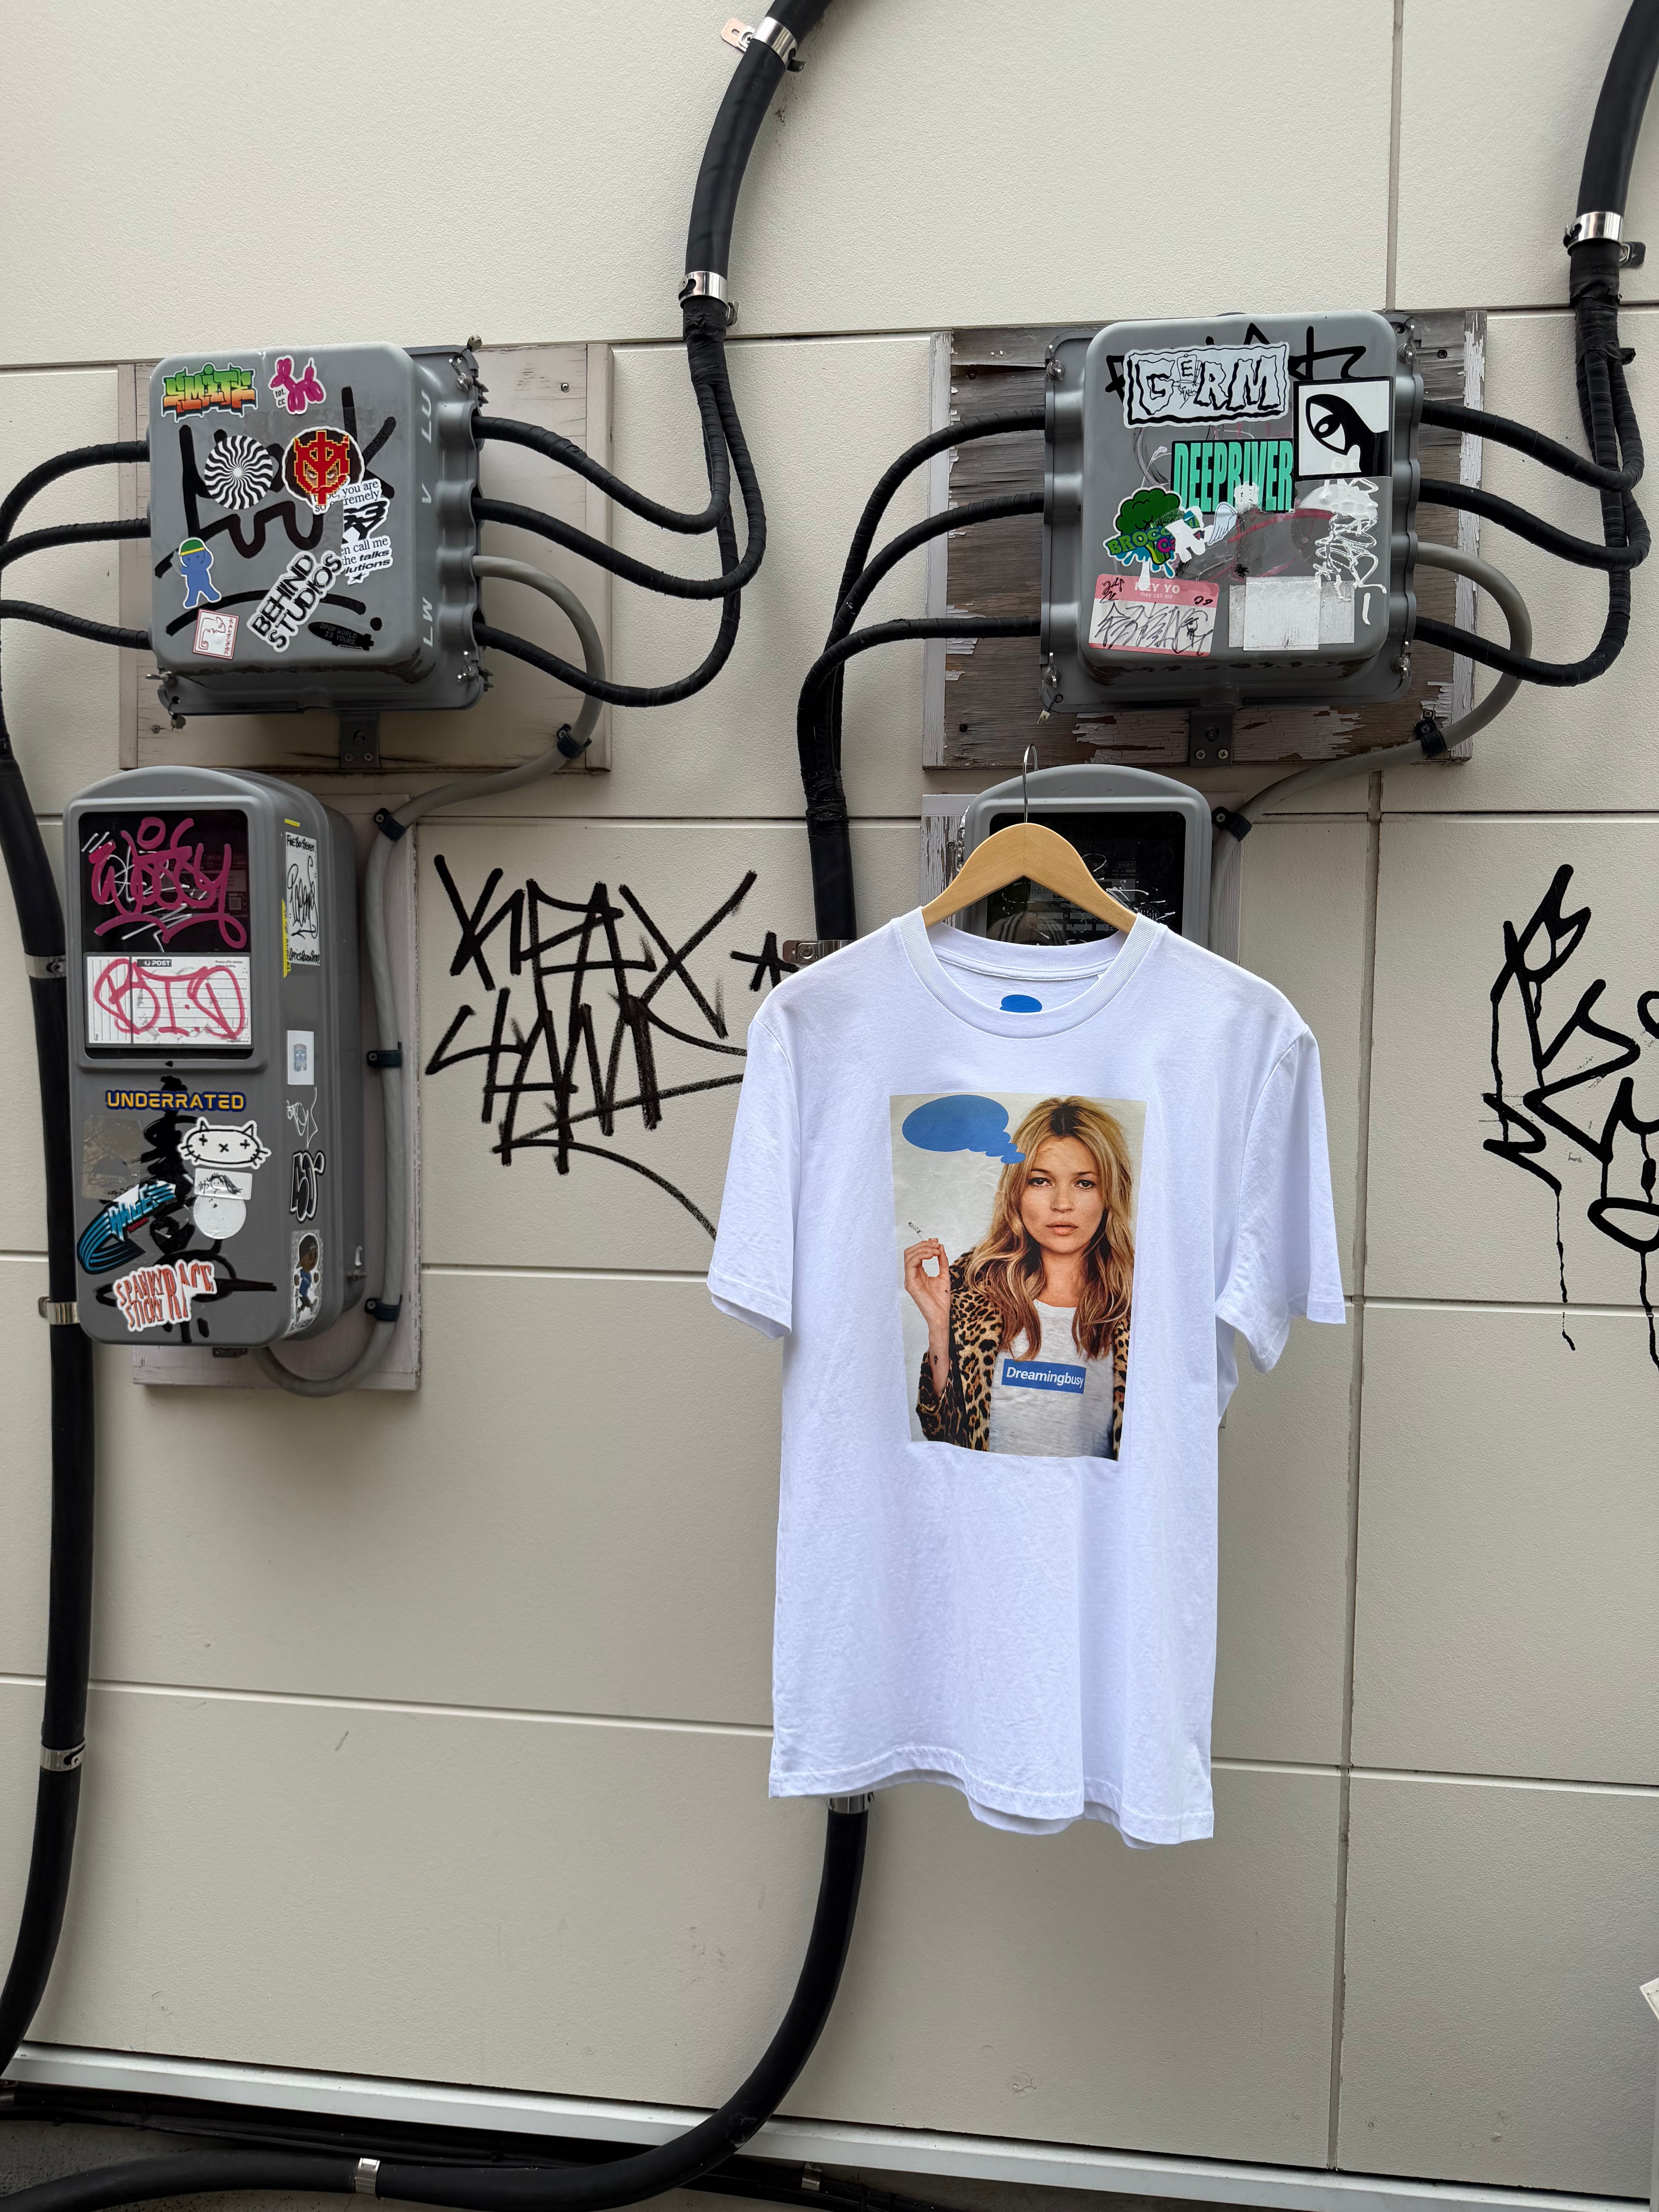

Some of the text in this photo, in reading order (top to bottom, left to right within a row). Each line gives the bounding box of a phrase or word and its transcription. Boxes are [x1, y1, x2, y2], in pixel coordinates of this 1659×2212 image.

[1173, 441, 1293, 512] DEEPRIVER
[342, 485, 360, 497] you
[363, 482, 378, 491] are
[341, 538, 388, 556] en call me
[359, 550, 389, 561] talks
[344, 559, 391, 574] lutions
[251, 555, 314, 637] BEHIND
[1164, 584, 1180, 594] YO
[268, 554, 342, 648] STUDIOS
[107, 1092, 244, 1109] UNDERRATED
[116, 1268, 164, 1306] SPANKY
[126, 1297, 164, 1328] STICKY
[1006, 1367, 1084, 1389] Dreamingbusy
